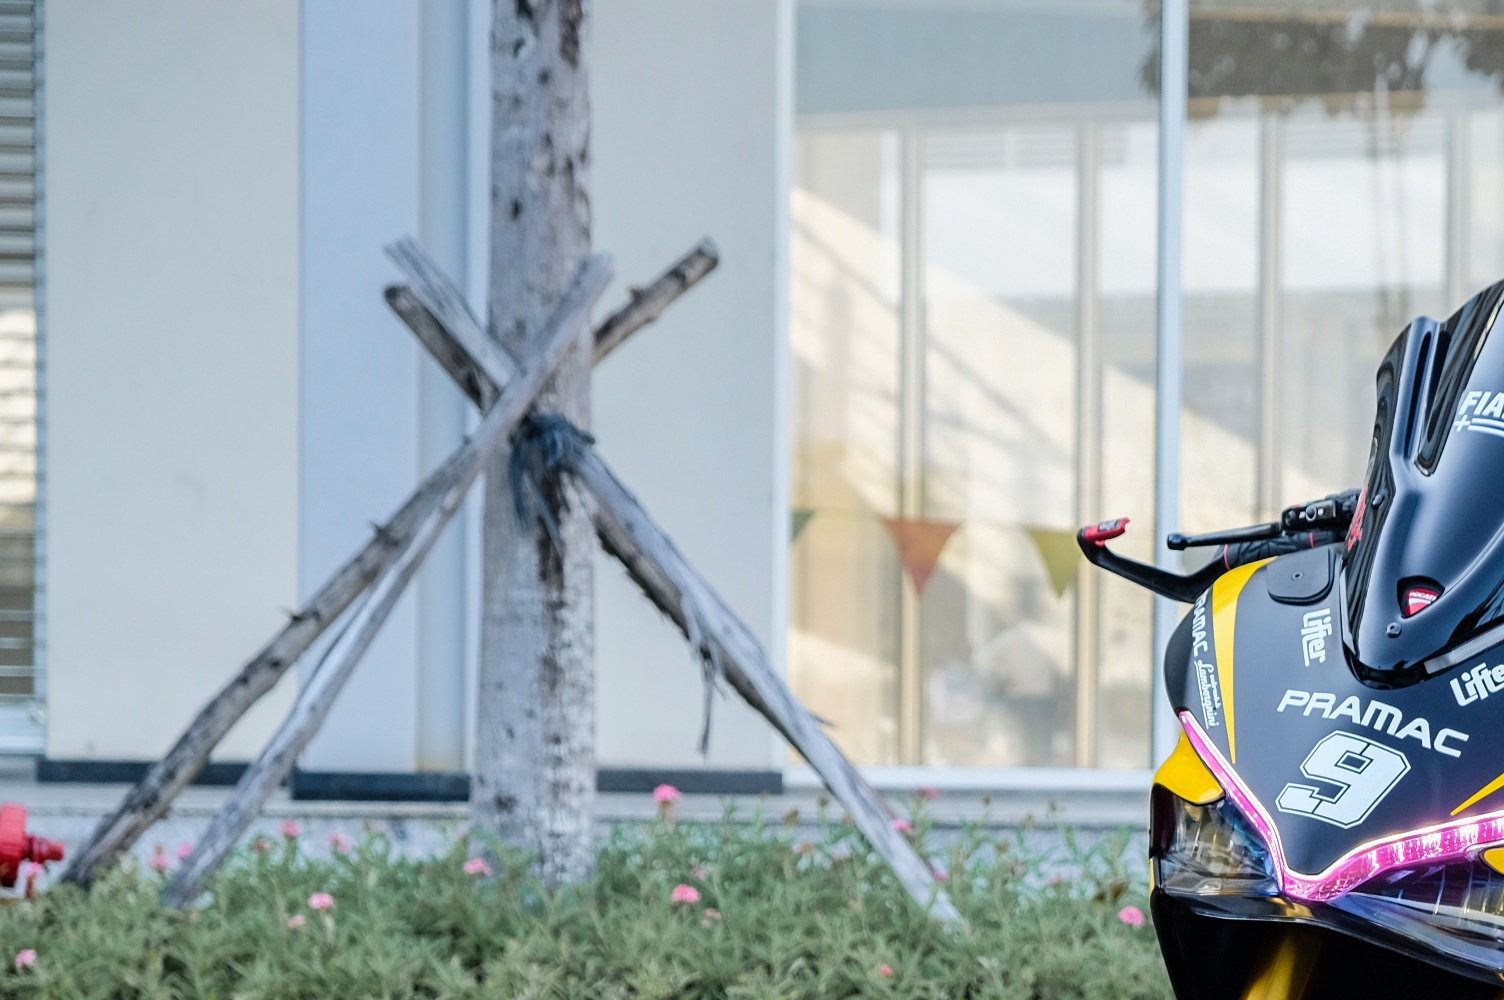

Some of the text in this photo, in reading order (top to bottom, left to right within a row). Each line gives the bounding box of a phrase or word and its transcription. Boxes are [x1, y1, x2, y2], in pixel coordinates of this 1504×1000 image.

[1300, 607, 1331, 668] Lifter
[1277, 689, 1470, 758] PRAMAC
[1275, 730, 1412, 830] 9
